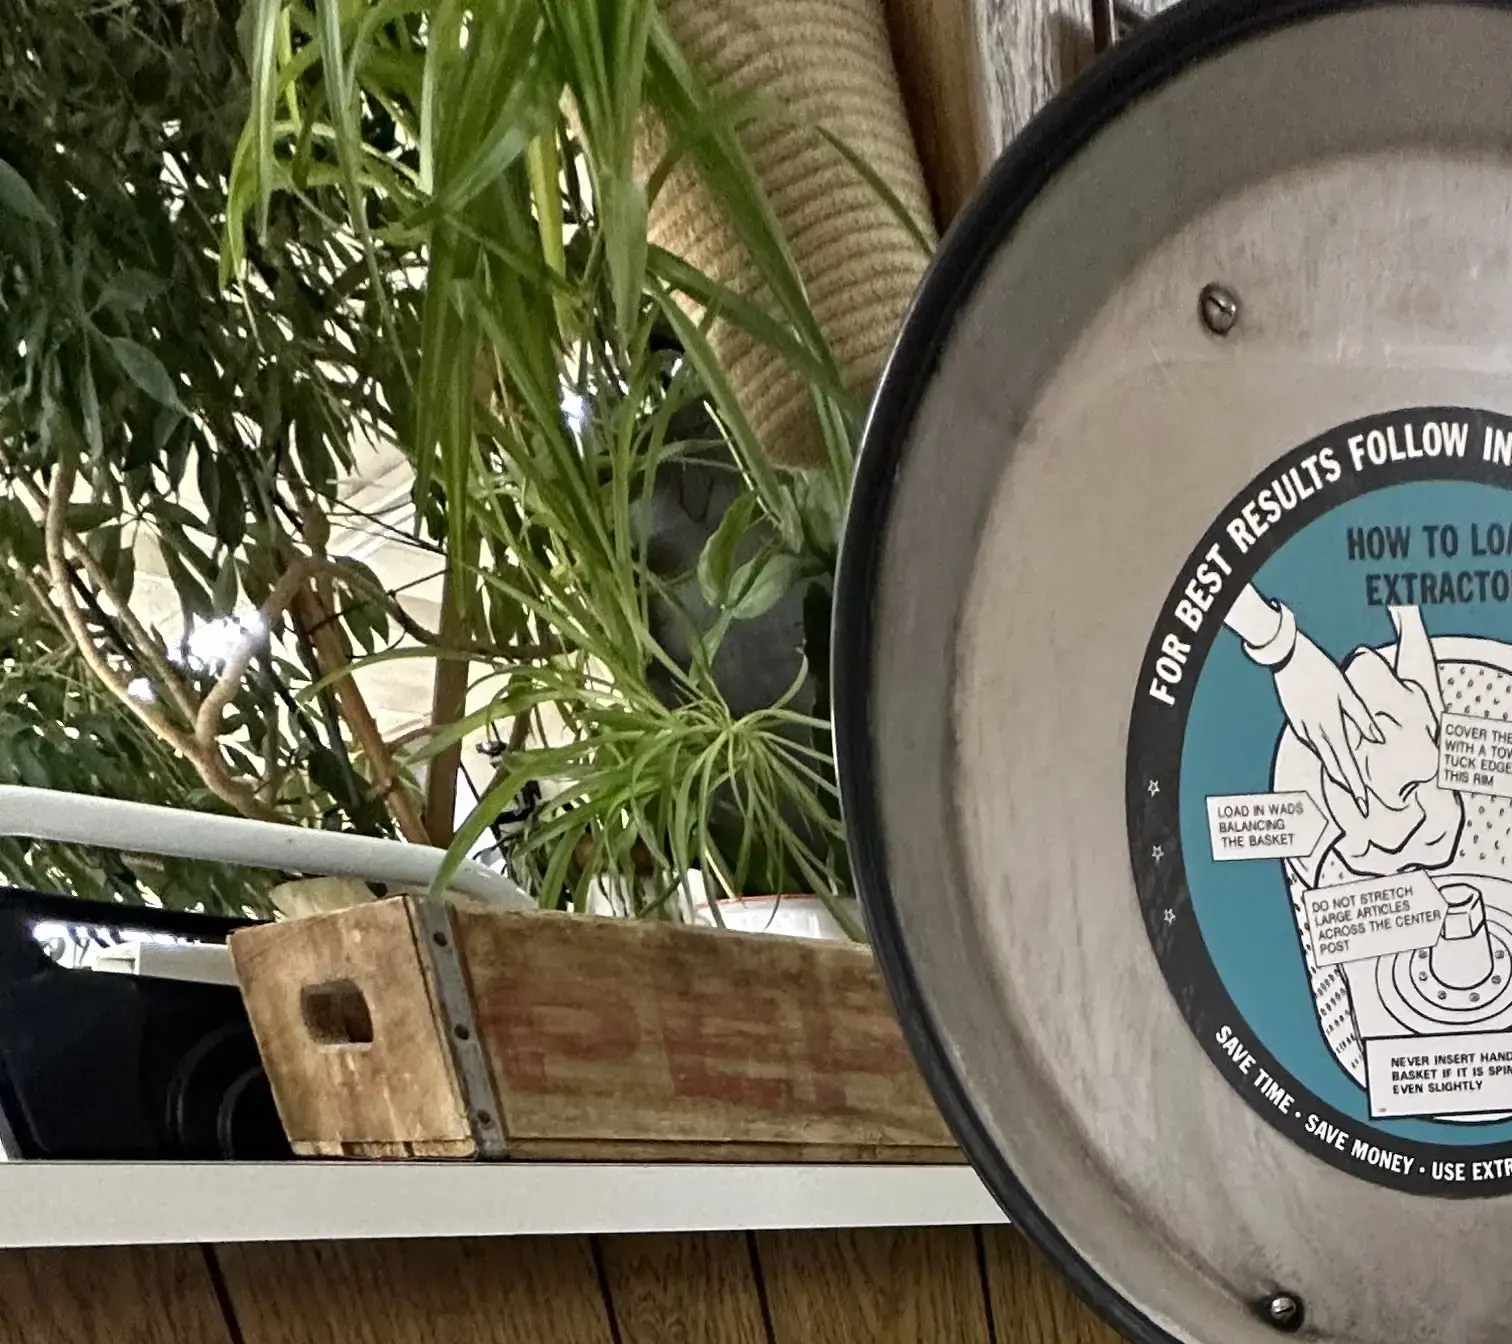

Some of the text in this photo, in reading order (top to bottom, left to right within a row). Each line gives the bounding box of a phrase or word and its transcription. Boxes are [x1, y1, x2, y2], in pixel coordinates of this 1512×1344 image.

[1347, 525, 1411, 560] HOW
[1422, 523, 1458, 558] TO
[1149, 633, 1191, 705] FOR
[1174, 543, 1232, 632] BEST
[1226, 447, 1342, 553] RESULTS
[1347, 421, 1468, 471] FOLLOW
[1445, 724, 1487, 740] COVER
[1445, 740, 1474, 753] WITH
[1478, 744, 1486, 756] A
[1444, 754, 1476, 768] TUCK
[1444, 769, 1494, 786] THIS RIM
[1218, 801, 1304, 818] LOAD IN WADS
[1219, 819, 1285, 832] BALANCING
[1222, 833, 1295, 848] THE BASKET
[1312, 886, 1413, 912] DO NOT STRETCH
[1314, 900, 1410, 926] LARGE ARTICLES
[1318, 909, 1440, 940] ACROSS THE CENTER
[1320, 940, 1349, 954] POST
[1391, 1056, 1429, 1068] NEVER
[1434, 1053, 1475, 1065] INSERT
[1392, 1069, 1437, 1082] BASKET
[1442, 1068, 1451, 1079] IF
[1457, 1067, 1468, 1077] IT
[1472, 1066, 1484, 1077] IS
[1393, 1080, 1483, 1095] EVEN SLIGHTLY
[1215, 1025, 1256, 1075] SAVE
[1253, 1068, 1295, 1115] TIME
[1304, 1113, 1350, 1151] SAVE
[1351, 1139, 1415, 1175] MONEY
[1431, 1161, 1466, 1182] USE
